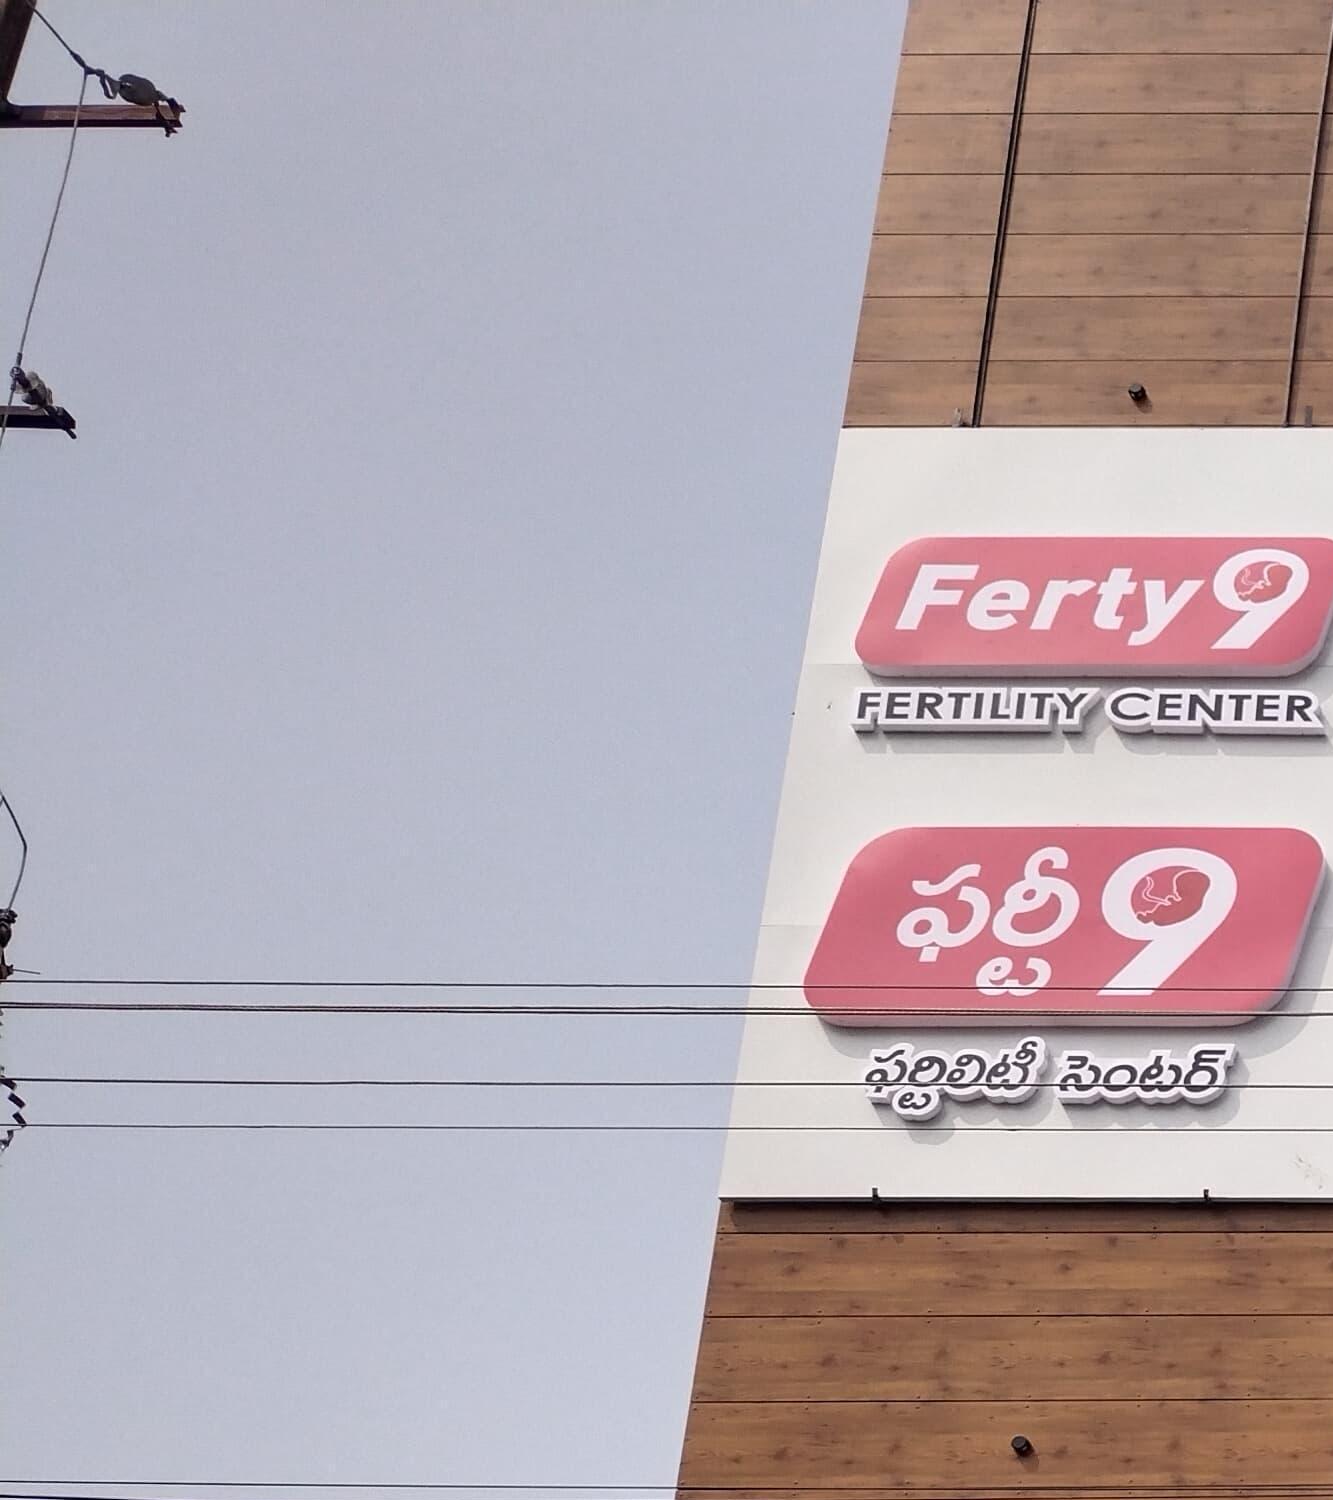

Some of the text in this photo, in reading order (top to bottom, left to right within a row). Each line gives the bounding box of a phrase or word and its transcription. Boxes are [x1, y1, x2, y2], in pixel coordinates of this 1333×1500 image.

[895, 548, 1309, 650] Ferty9
[855, 691, 1318, 723] FERTILITY CENTER
[1060, 1049, 1226, 1092] సెంటర్
